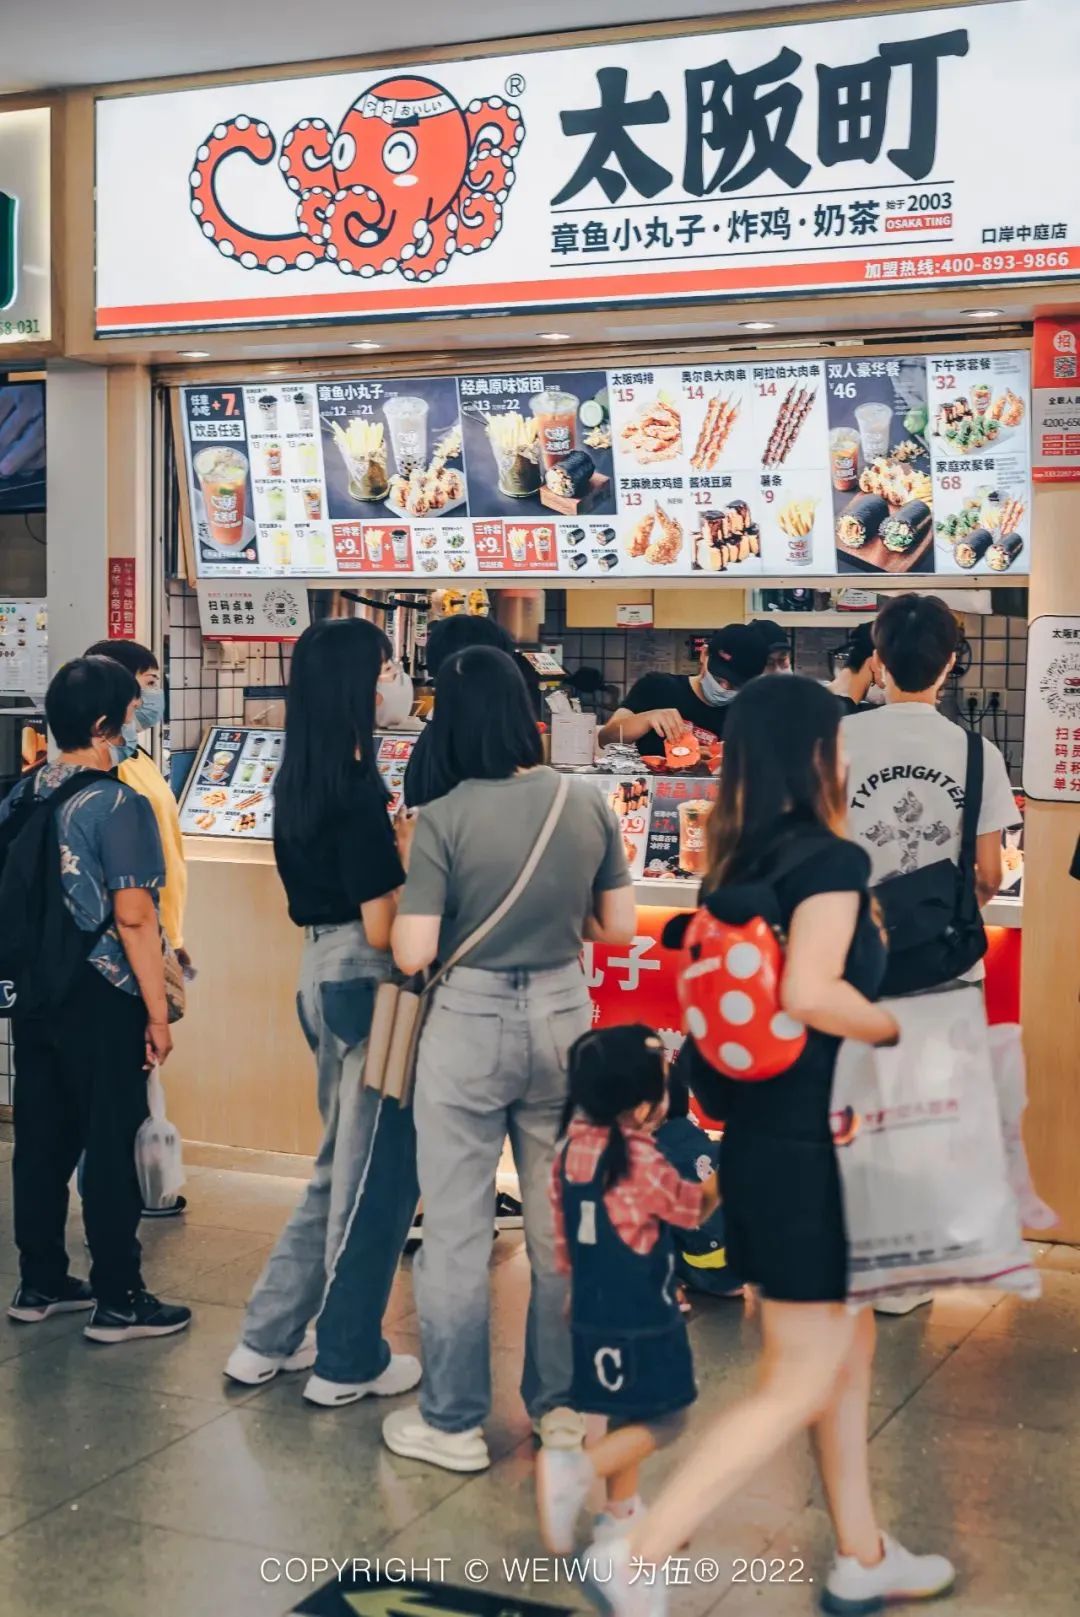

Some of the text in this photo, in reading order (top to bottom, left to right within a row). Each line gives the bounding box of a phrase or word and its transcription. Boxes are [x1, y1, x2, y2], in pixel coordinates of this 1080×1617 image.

[401, 102, 442, 117] おいしい
[551, 29, 969, 206] 太阪町
[886, 192, 952, 212] 始于 2003
[887, 215, 951, 229] OSAKA TING
[982, 223, 1068, 244] 口岸中庭店
[753, 364, 820, 380] 阿拉伯大肉串
[828, 361, 900, 378] 双人豪华餐
[931, 357, 991, 373] 下午茶套餐
[612, 372, 654, 385] 太阪鸡排
[681, 369, 746, 383] 奥尔良大肉串
[318, 384, 384, 401] 章鱼小丸子
[460, 376, 544, 396] 经典原味饭团
[194, 423, 241, 438] 饮品任选
[936, 458, 995, 473] 家庭欢聚餐
[620, 477, 683, 490] 芝麻脆皮鸡翅
[689, 476, 732, 488] 酱烧豆腐
[760, 474, 782, 487] 薯条
[208, 600, 254, 611] 扫码点单
[210, 614, 255, 625] 会员积分
[1054, 727, 1068, 790] 扫码点单
[594, 1347, 624, 1392] C
